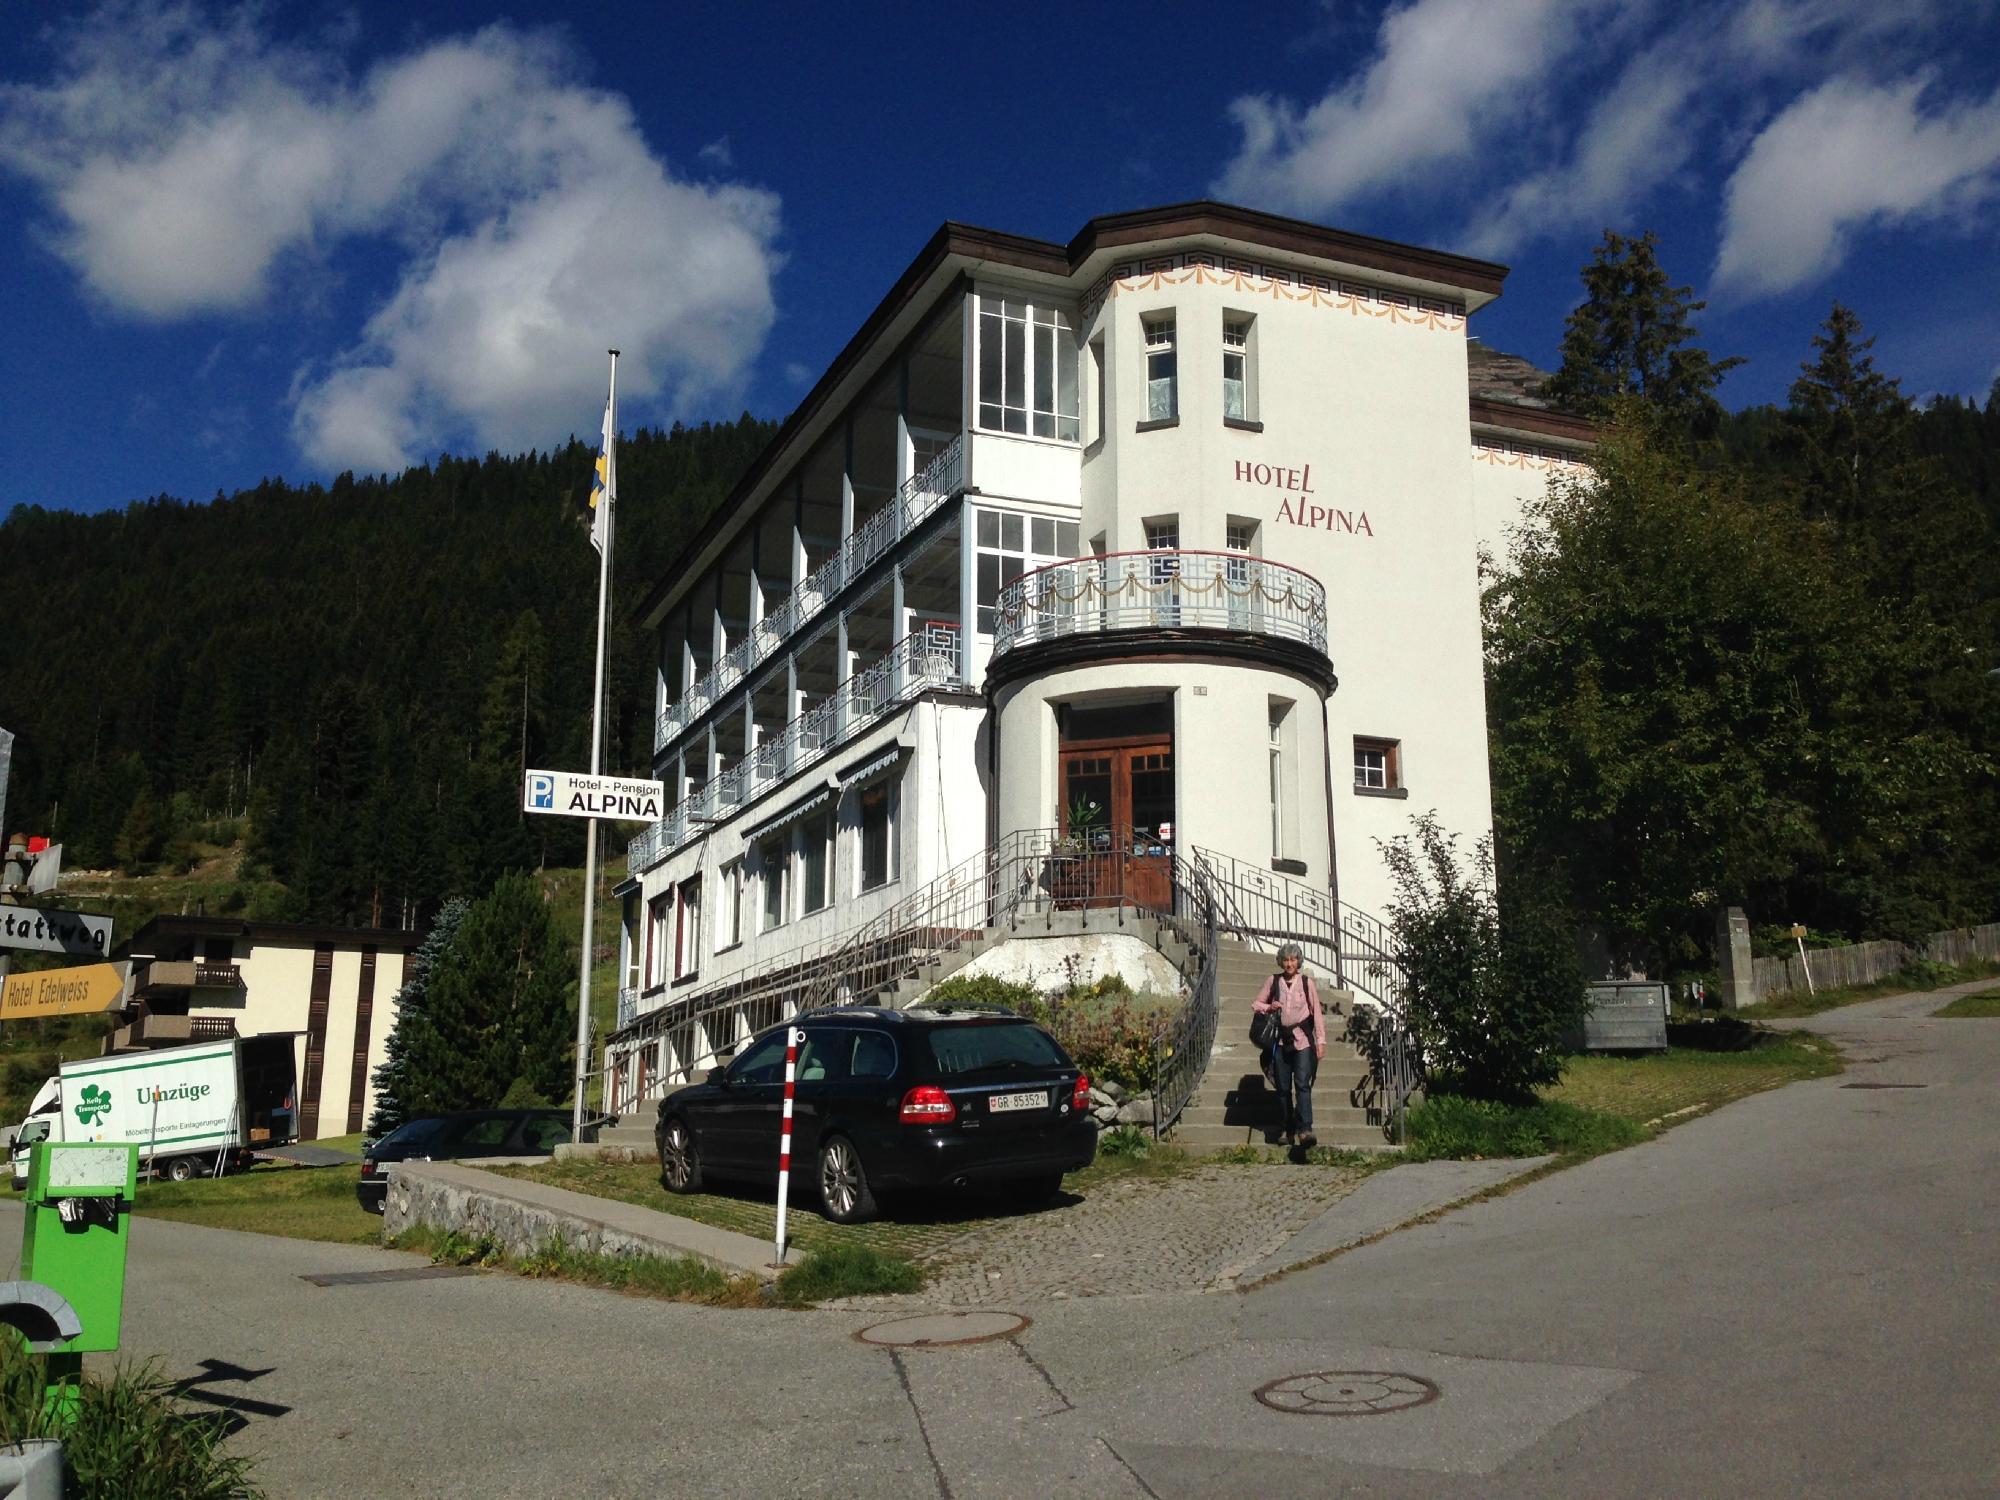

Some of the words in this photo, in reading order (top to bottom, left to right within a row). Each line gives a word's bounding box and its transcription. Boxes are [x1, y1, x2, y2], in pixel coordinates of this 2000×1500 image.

[1235, 460, 1314, 493] HOTEL
[1275, 496, 1373, 536] ALPINA
[569, 778, 601, 790] Hotel
[613, 782, 660, 796] Pension
[568, 792, 659, 817] ALPINA
[0, 913, 105, 951] tattweg
[8, 982, 33, 1008] Hotel
[38, 977, 89, 1005] Edelweiss
[137, 1083, 210, 1104] Umzüge
[997, 1096, 1009, 1109] GR
[1013, 1093, 1040, 1107] 85352
